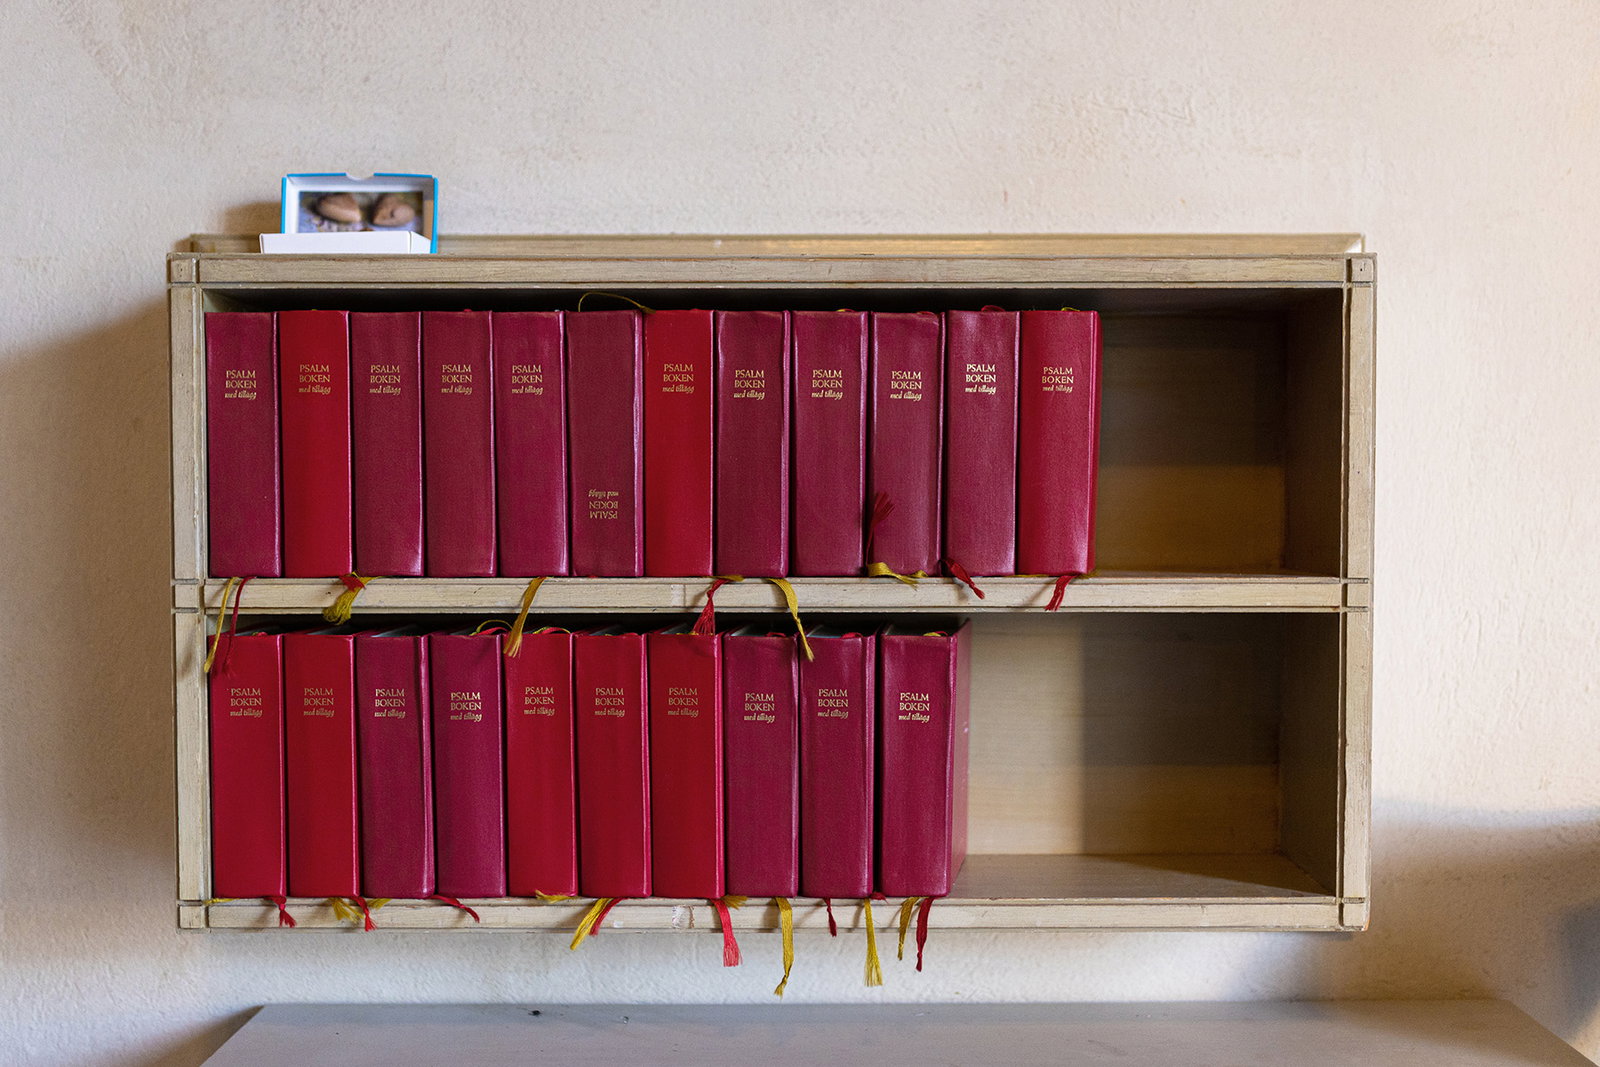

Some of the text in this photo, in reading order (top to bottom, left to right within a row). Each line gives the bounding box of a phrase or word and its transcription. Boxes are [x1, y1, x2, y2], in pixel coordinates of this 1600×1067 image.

[371, 365, 400, 373] PSALM
[442, 365, 471, 373] PSALM
[512, 365, 541, 373] PSALM
[664, 364, 693, 372] PSALM
[967, 364, 995, 372] PSALM
[1044, 367, 1072, 375] PSALM
[226, 370, 255, 378] PSALM
[663, 374, 693, 382] BOKEN
[736, 370, 764, 378] PSALM
[813, 370, 842, 378] PSALM
[892, 371, 921, 379] PSALM
[966, 374, 996, 382] BOKEN
[300, 374, 330, 383] BOKEN
[370, 375, 400, 383] BOKEN
[442, 375, 472, 383] BOKEN
[512, 375, 542, 383] BOKEN
[1042, 376, 1074, 384] BOKEN
[226, 380, 256, 388] BOKEN
[735, 380, 765, 388] BOKEN
[813, 380, 842, 388] BOKEN
[891, 381, 922, 389] BOKEN
[370, 385, 382, 393] med
[441, 385, 453, 393] med
[225, 390, 237, 398] med
[734, 390, 746, 398] med
[890, 391, 902, 399] med
[589, 501, 618, 509] BOKEN
[590, 511, 617, 519] PSALM
[231, 688, 261, 696] PSALM
[304, 688, 333, 696] PSALM
[376, 689, 404, 697] PSALM
[525, 687, 553, 695] PSALM
[819, 689, 847, 697] PSALM
[451, 692, 480, 701] PSALM
[745, 693, 774, 701] PSALM
[900, 693, 929, 701] PSALM
[231, 698, 261, 706] BOKEN
[304, 698, 334, 706] BOKEN
[375, 699, 405, 707] BOKEN
[669, 697, 698, 705] BOKEN
[818, 699, 848, 707] BOKEN
[451, 702, 481, 710] BOKEN
[745, 703, 774, 711] BOKEN
[900, 703, 929, 711] BOKEN
[230, 708, 242, 716] med
[374, 709, 387, 717] med
[818, 709, 830, 717] med
